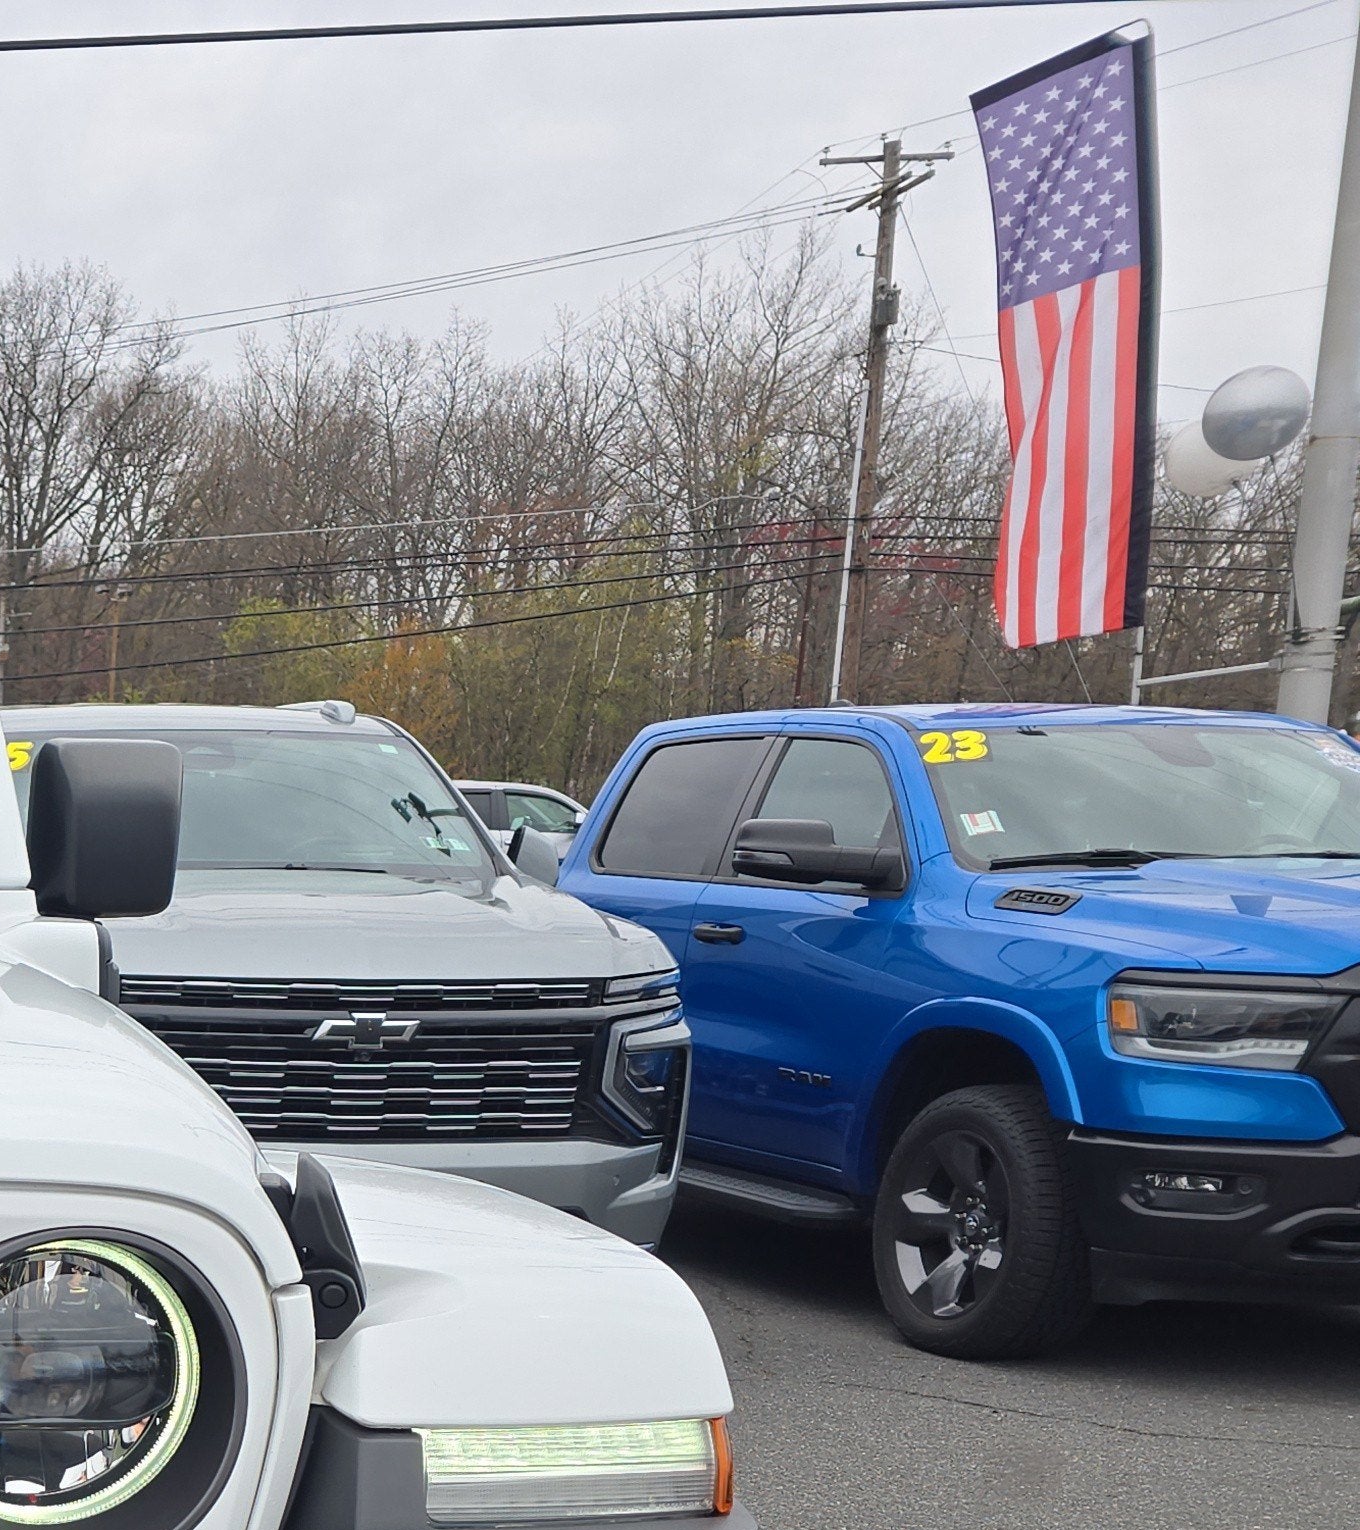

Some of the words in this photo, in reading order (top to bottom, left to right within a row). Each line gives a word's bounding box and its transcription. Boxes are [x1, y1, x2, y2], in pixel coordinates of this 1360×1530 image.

[6, 741, 35, 771] 5
[920, 730, 989, 764] 23
[1011, 891, 1066, 906] 1500
